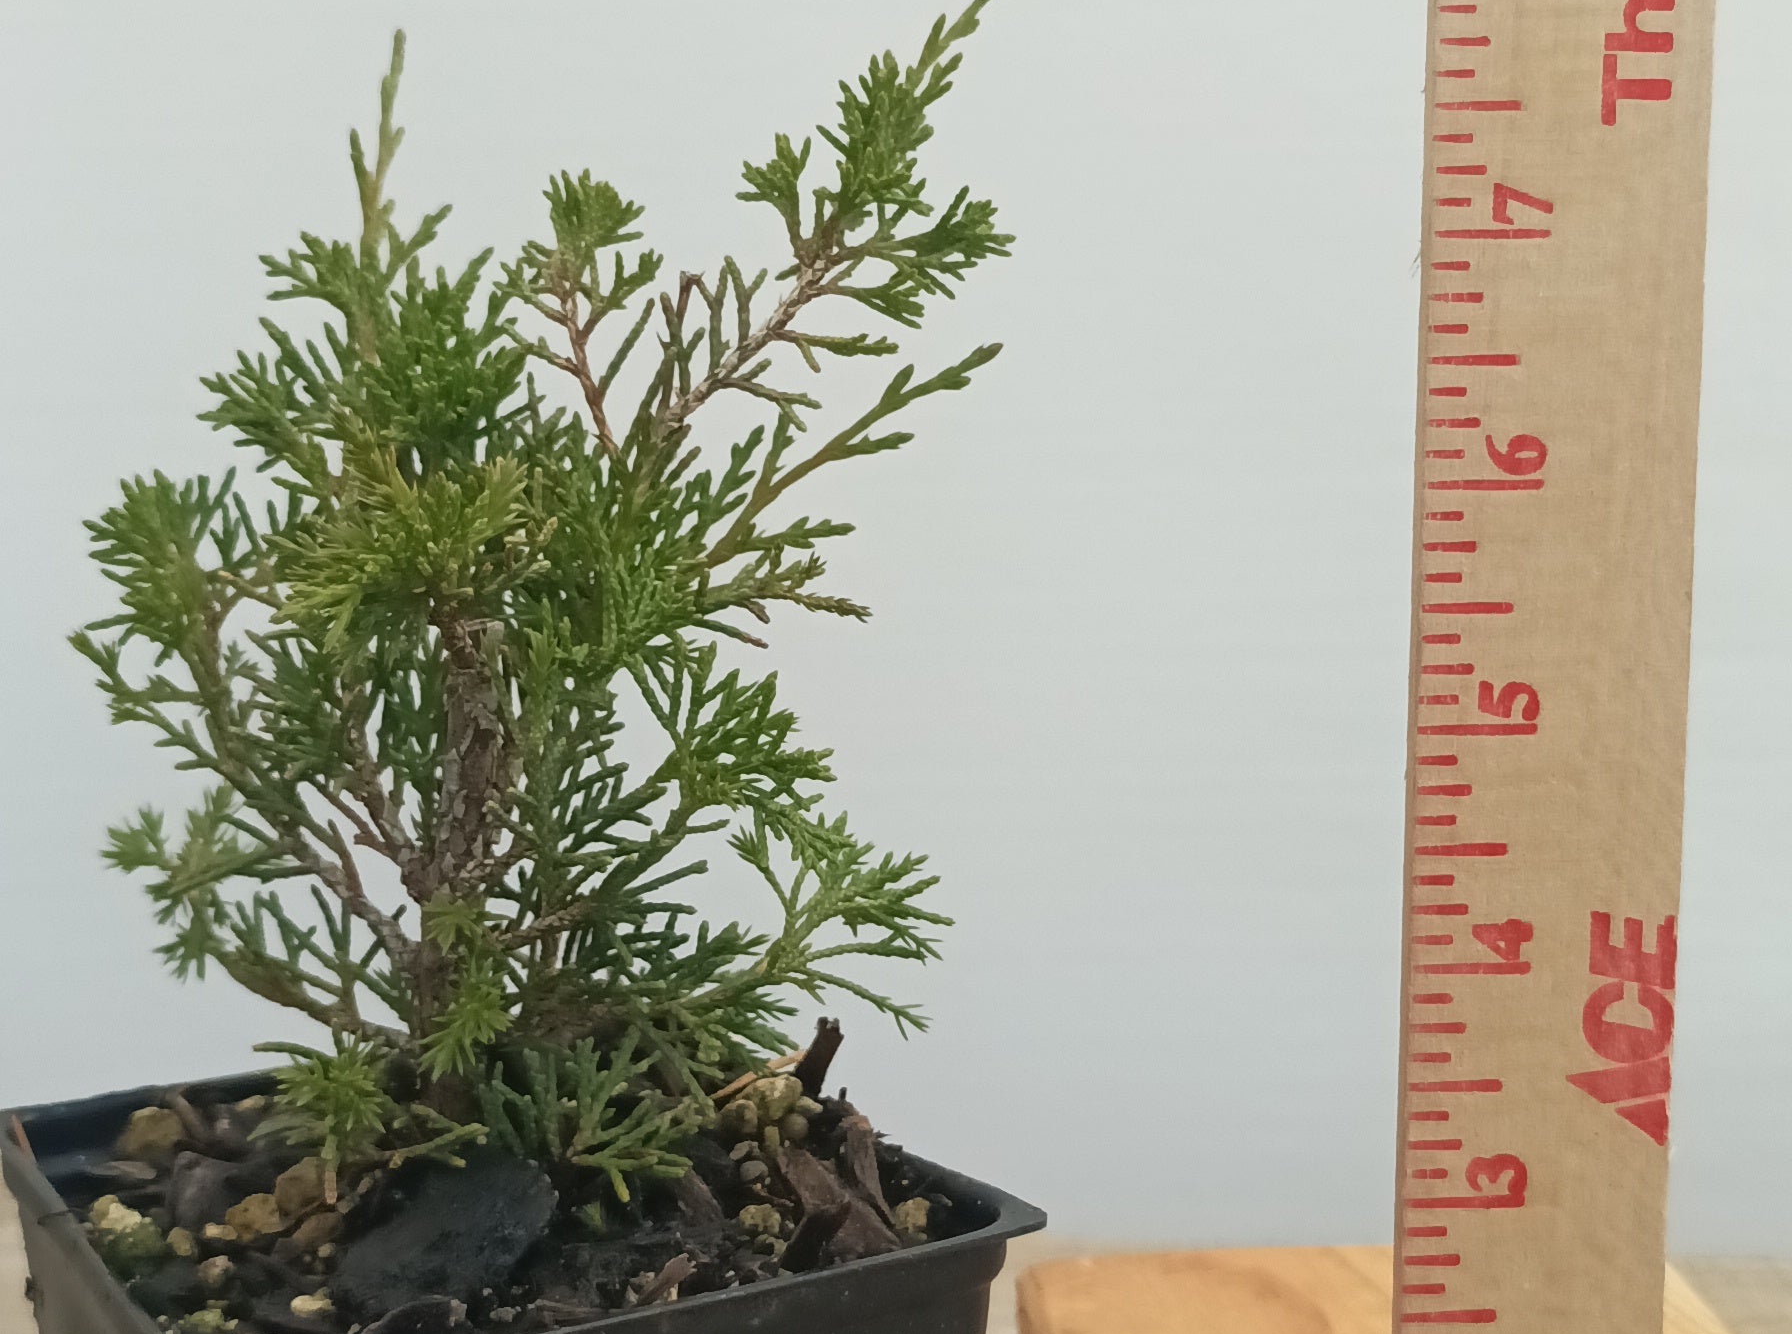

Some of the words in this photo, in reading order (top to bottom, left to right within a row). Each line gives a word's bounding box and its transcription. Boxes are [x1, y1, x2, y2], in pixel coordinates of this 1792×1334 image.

[1491, 181, 1555, 226] 7
[1484, 433, 1548, 477] 6
[1477, 680, 1542, 721] 5
[1471, 918, 1535, 962] 4
[1565, 909, 1678, 1147] ACE
[1464, 1153, 1529, 1197] 3
